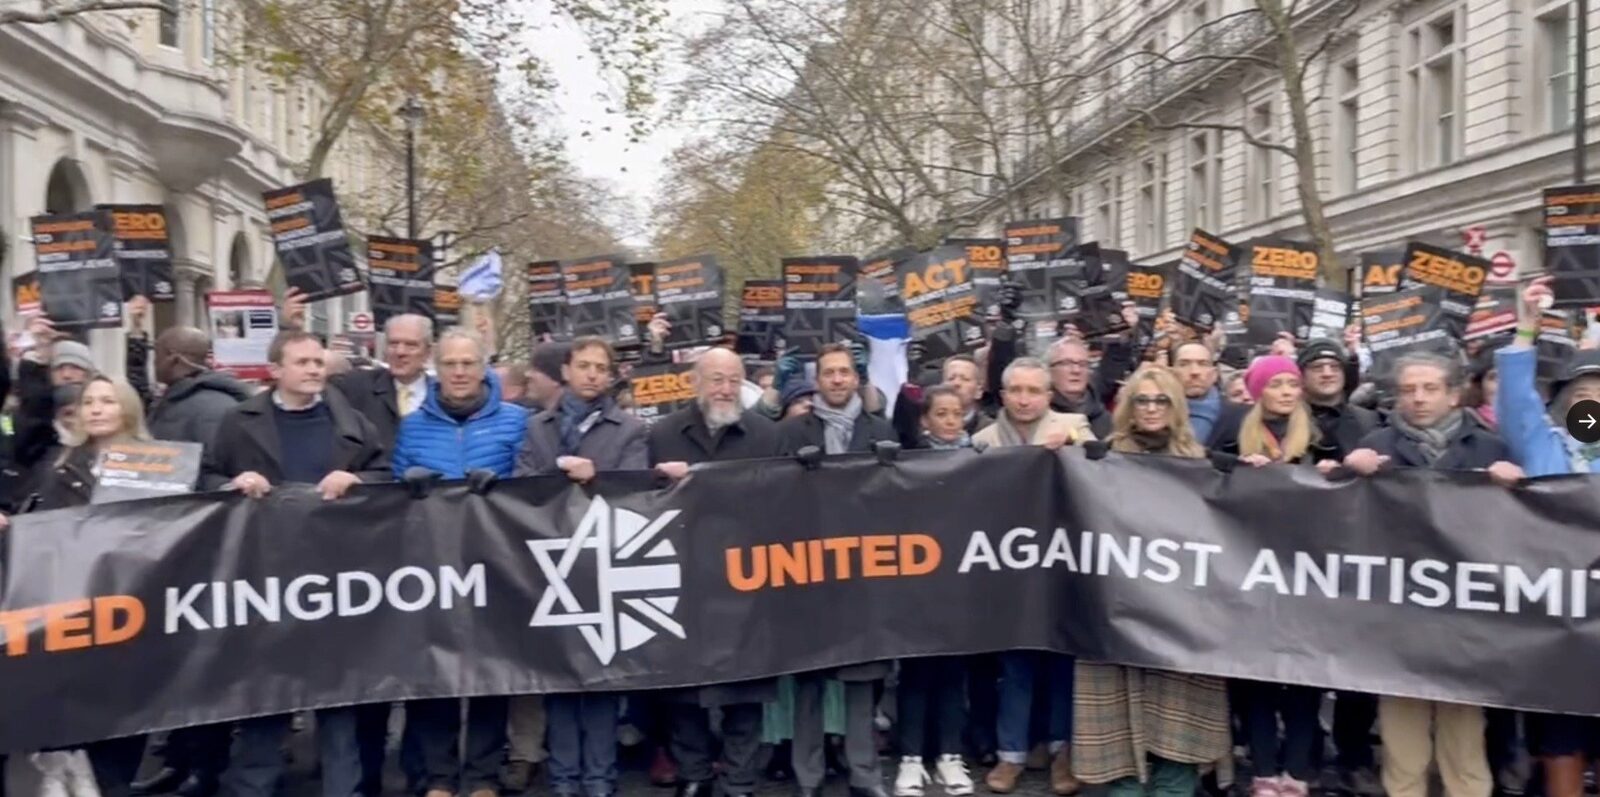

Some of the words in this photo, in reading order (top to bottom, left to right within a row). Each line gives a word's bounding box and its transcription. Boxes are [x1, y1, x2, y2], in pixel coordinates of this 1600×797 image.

[112, 212, 166, 230] ERO
[1252, 246, 1318, 270] ZERO
[1409, 250, 1484, 285] ZERO
[903, 258, 967, 298] ACT
[631, 370, 696, 396] ZERO
[0, 595, 147, 657] TED
[164, 563, 488, 634] KINGDOM
[725, 532, 943, 592] UNITED
[958, 528, 1223, 586] AGAINST
[1240, 548, 1600, 618] ANTISEMI
